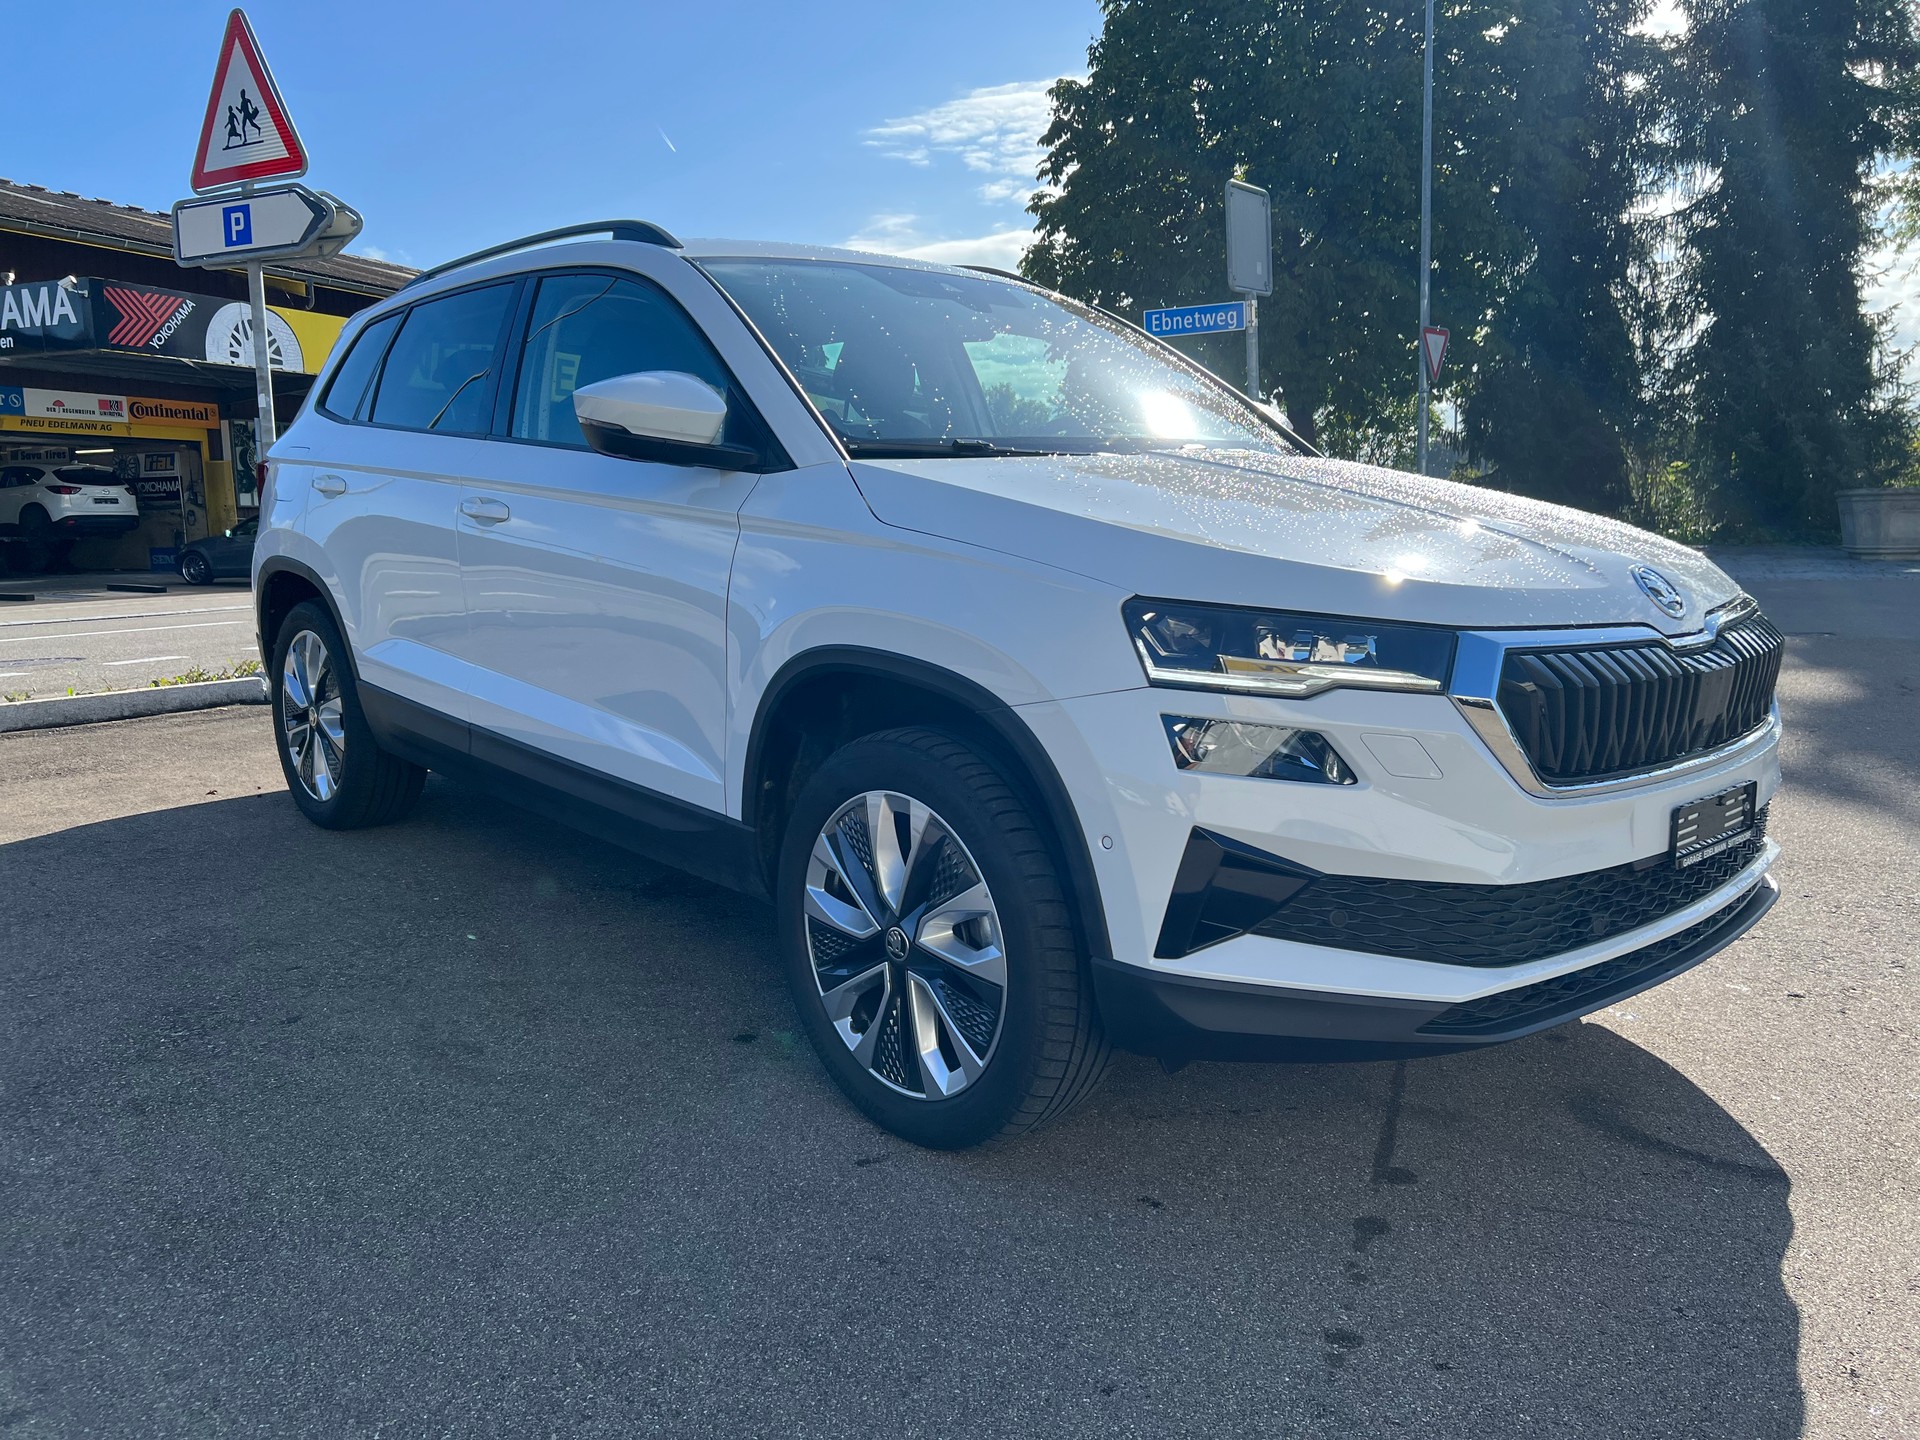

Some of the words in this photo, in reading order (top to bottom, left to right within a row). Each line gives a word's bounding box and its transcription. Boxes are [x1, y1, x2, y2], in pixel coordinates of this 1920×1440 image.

[230, 212, 245, 241] P
[0, 286, 78, 330] AMA
[149, 299, 196, 350] YOKOHAMA
[1152, 309, 1237, 332] Ebnetweg
[129, 401, 209, 420] Continental
[20, 419, 45, 428] PNEU
[48, 421, 98, 431] EDELMANN
[99, 424, 112, 432] AG
[20, 451, 42, 461] Sava
[44, 450, 67, 460] Tires
[135, 480, 180, 493] YOKOHAMA
[1682, 852, 1703, 867] GARAGE
